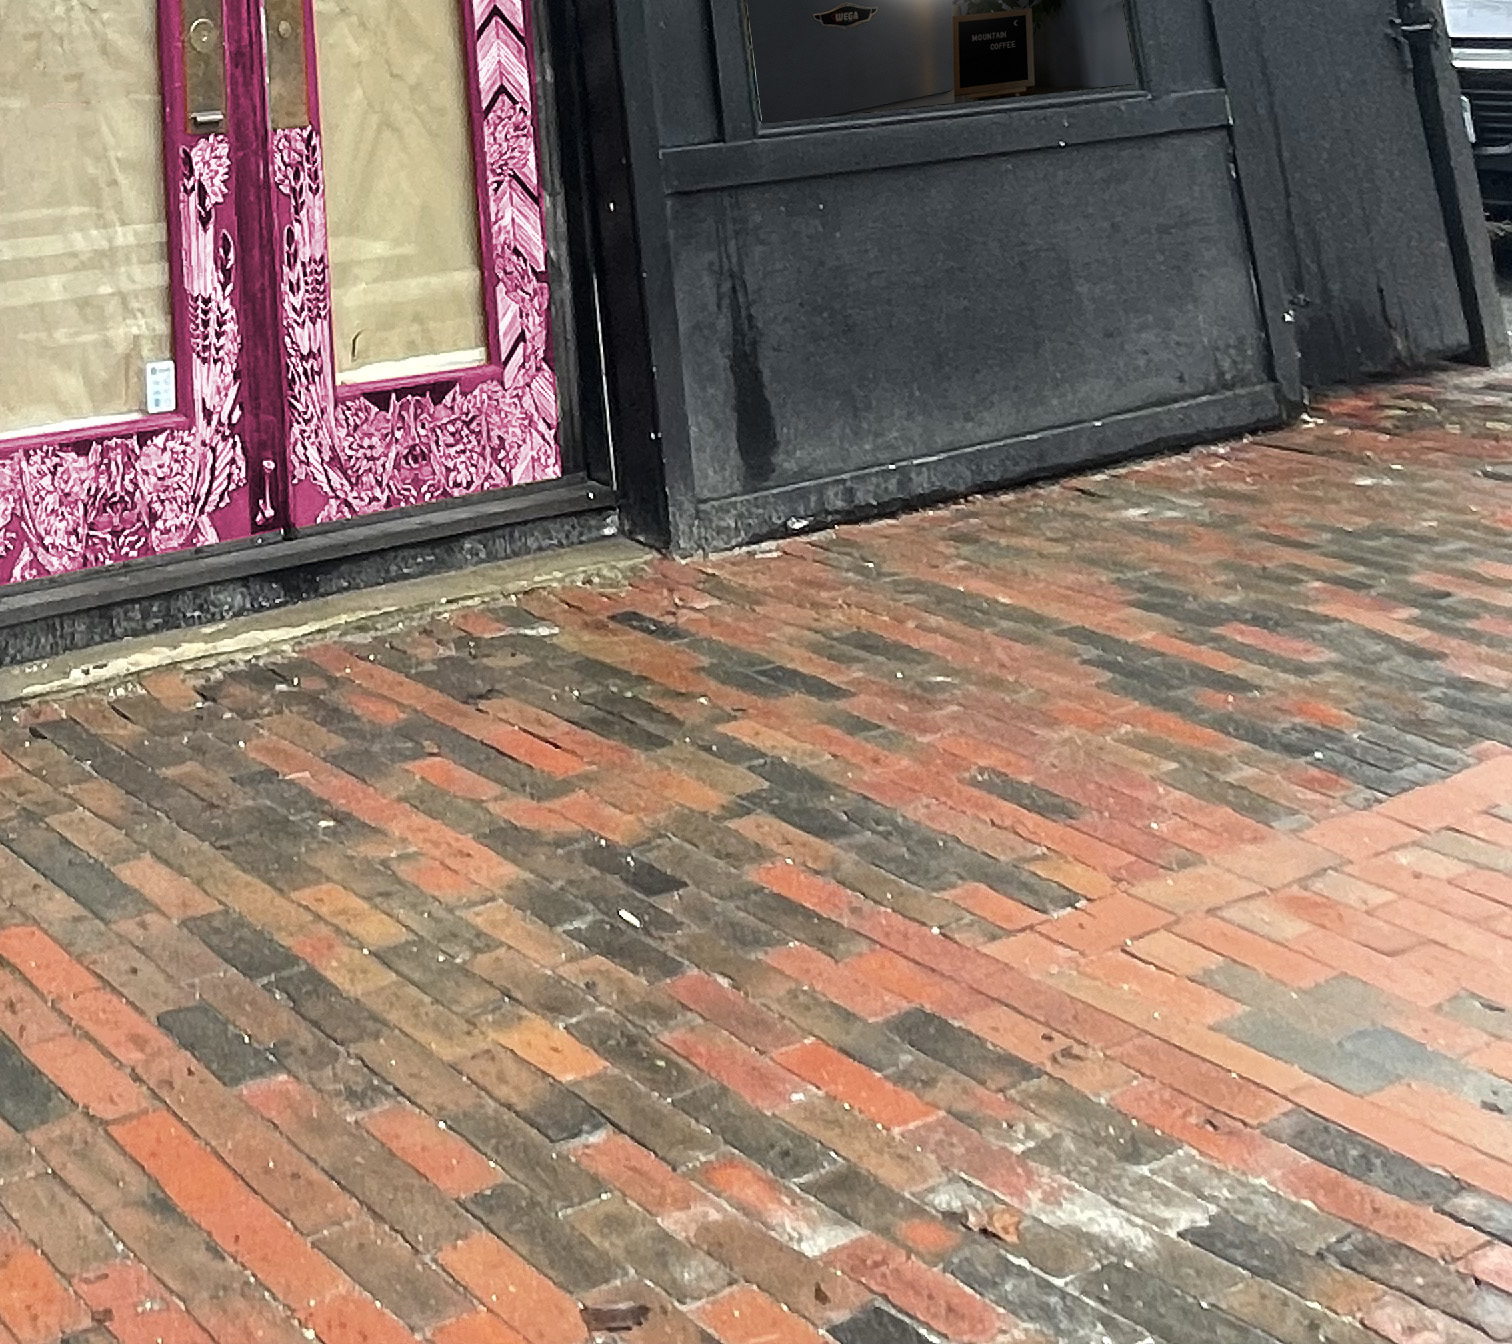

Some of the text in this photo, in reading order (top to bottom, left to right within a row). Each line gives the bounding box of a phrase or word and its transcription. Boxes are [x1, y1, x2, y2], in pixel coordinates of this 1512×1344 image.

[835, 11, 859, 22] WEGA
[971, 31, 1007, 42] MOUNTAIN
[990, 40, 1016, 50] COFFEE
